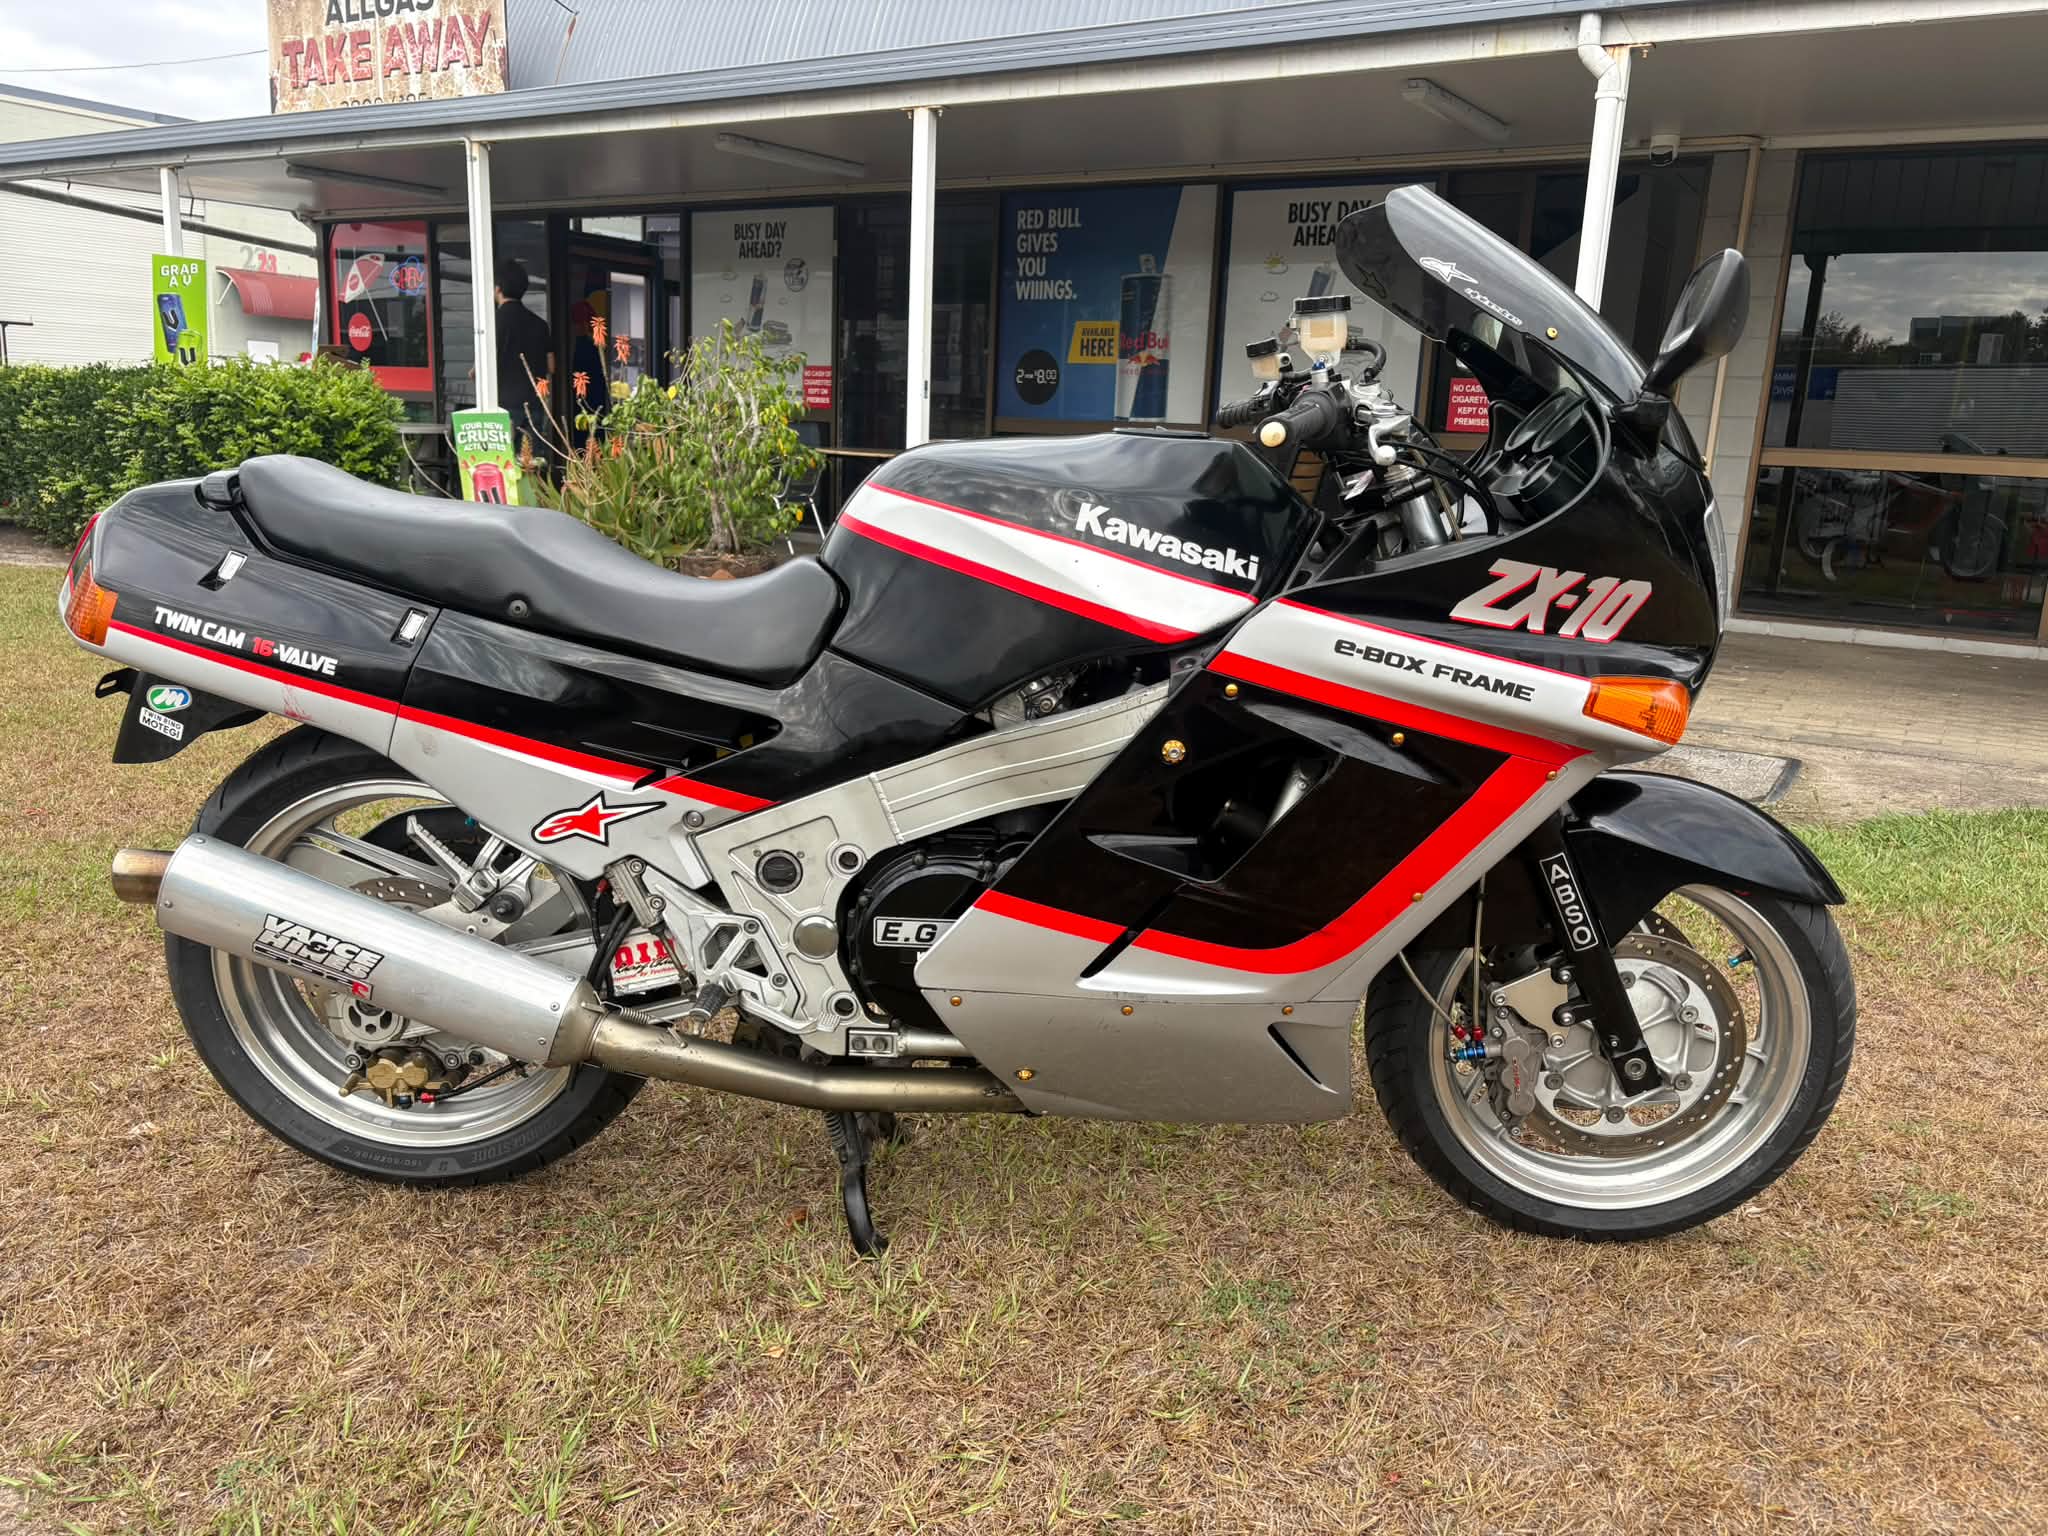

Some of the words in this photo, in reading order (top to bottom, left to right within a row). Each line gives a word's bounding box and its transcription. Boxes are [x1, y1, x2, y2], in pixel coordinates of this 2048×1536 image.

[281, 30, 373, 89] TAKE
[383, 11, 491, 77] AWAY
[1017, 209, 1043, 230] RED
[1048, 208, 1082, 228] BULL
[1288, 201, 1332, 224] BUSY
[734, 222, 761, 240] BUSY
[765, 221, 787, 239] DAY
[1293, 224, 1337, 246] AHEA
[739, 241, 782, 259] AHEAD?
[1017, 232, 1058, 253] GIVES
[160, 263, 198, 276] GRAB
[1017, 257, 1046, 277] YOU
[169, 277, 178, 287] A
[1016, 280, 1077, 300] WIIINGS.
[1082, 328, 1114, 337] AVAILABLE
[1120, 332, 1144, 349] Red
[1080, 338, 1114, 357] HERE
[1016, 369, 1024, 384] 2
[1453, 384, 1464, 392] NO
[1452, 396, 1488, 405] CIGARETT
[1457, 407, 1477, 415] KEPT
[1478, 407, 1488, 415] ON
[461, 422, 481, 430] YOUR
[484, 422, 503, 430] NEW
[457, 430, 511, 444] CRUSH
[1075, 503, 1260, 581] Kawasaki
[1449, 558, 1652, 643] ZX-10
[155, 606, 202, 636] TWIN
[201, 622, 246, 649] CAM
[252, 636, 339, 676] 16-VALVE
[1432, 663, 1536, 703] FRAME
[144, 708, 162, 721] TWIN
[142, 716, 180, 739] MOTEGI
[1551, 863, 1592, 945] ABSO
[264, 913, 385, 968] VANCE
[255, 928, 372, 980] HINES
